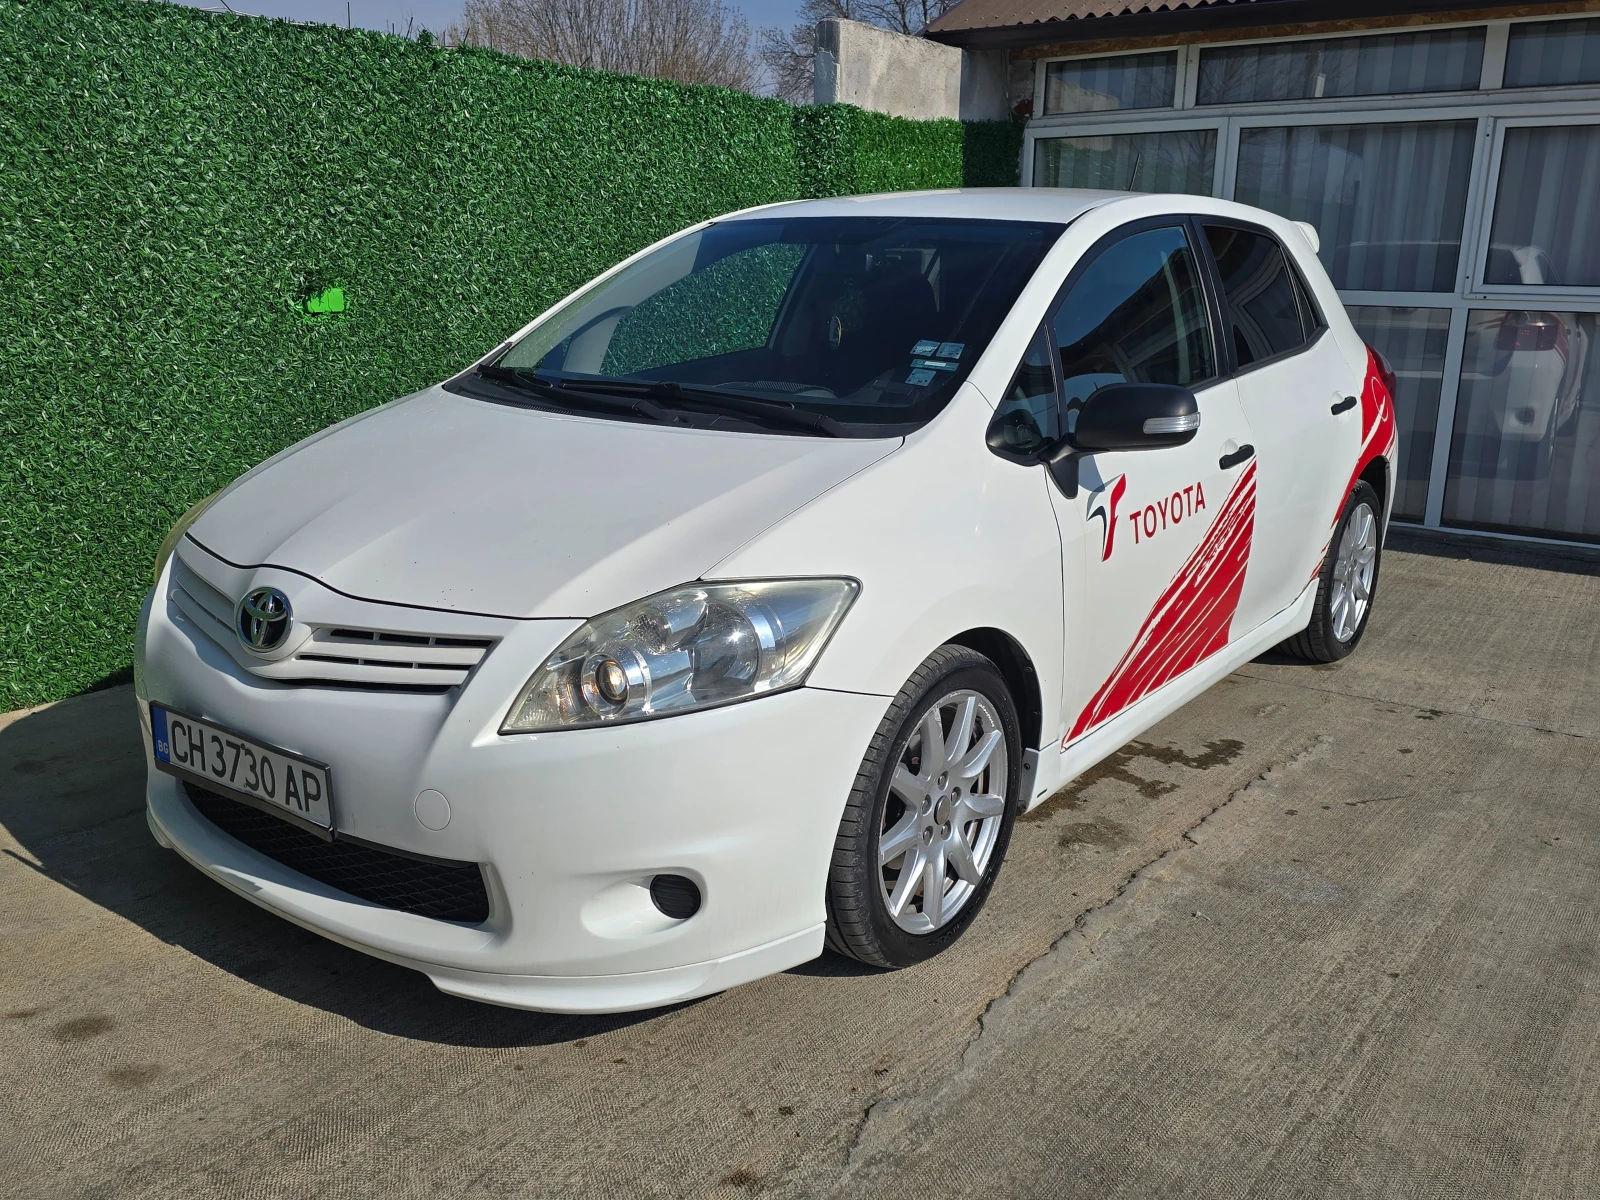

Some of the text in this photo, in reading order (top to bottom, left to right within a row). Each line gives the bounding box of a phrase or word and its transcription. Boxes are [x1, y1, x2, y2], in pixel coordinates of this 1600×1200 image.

[1129, 481, 1206, 544] TOYOTA
[157, 739, 169, 754] BG
[285, 764, 321, 812] AP
